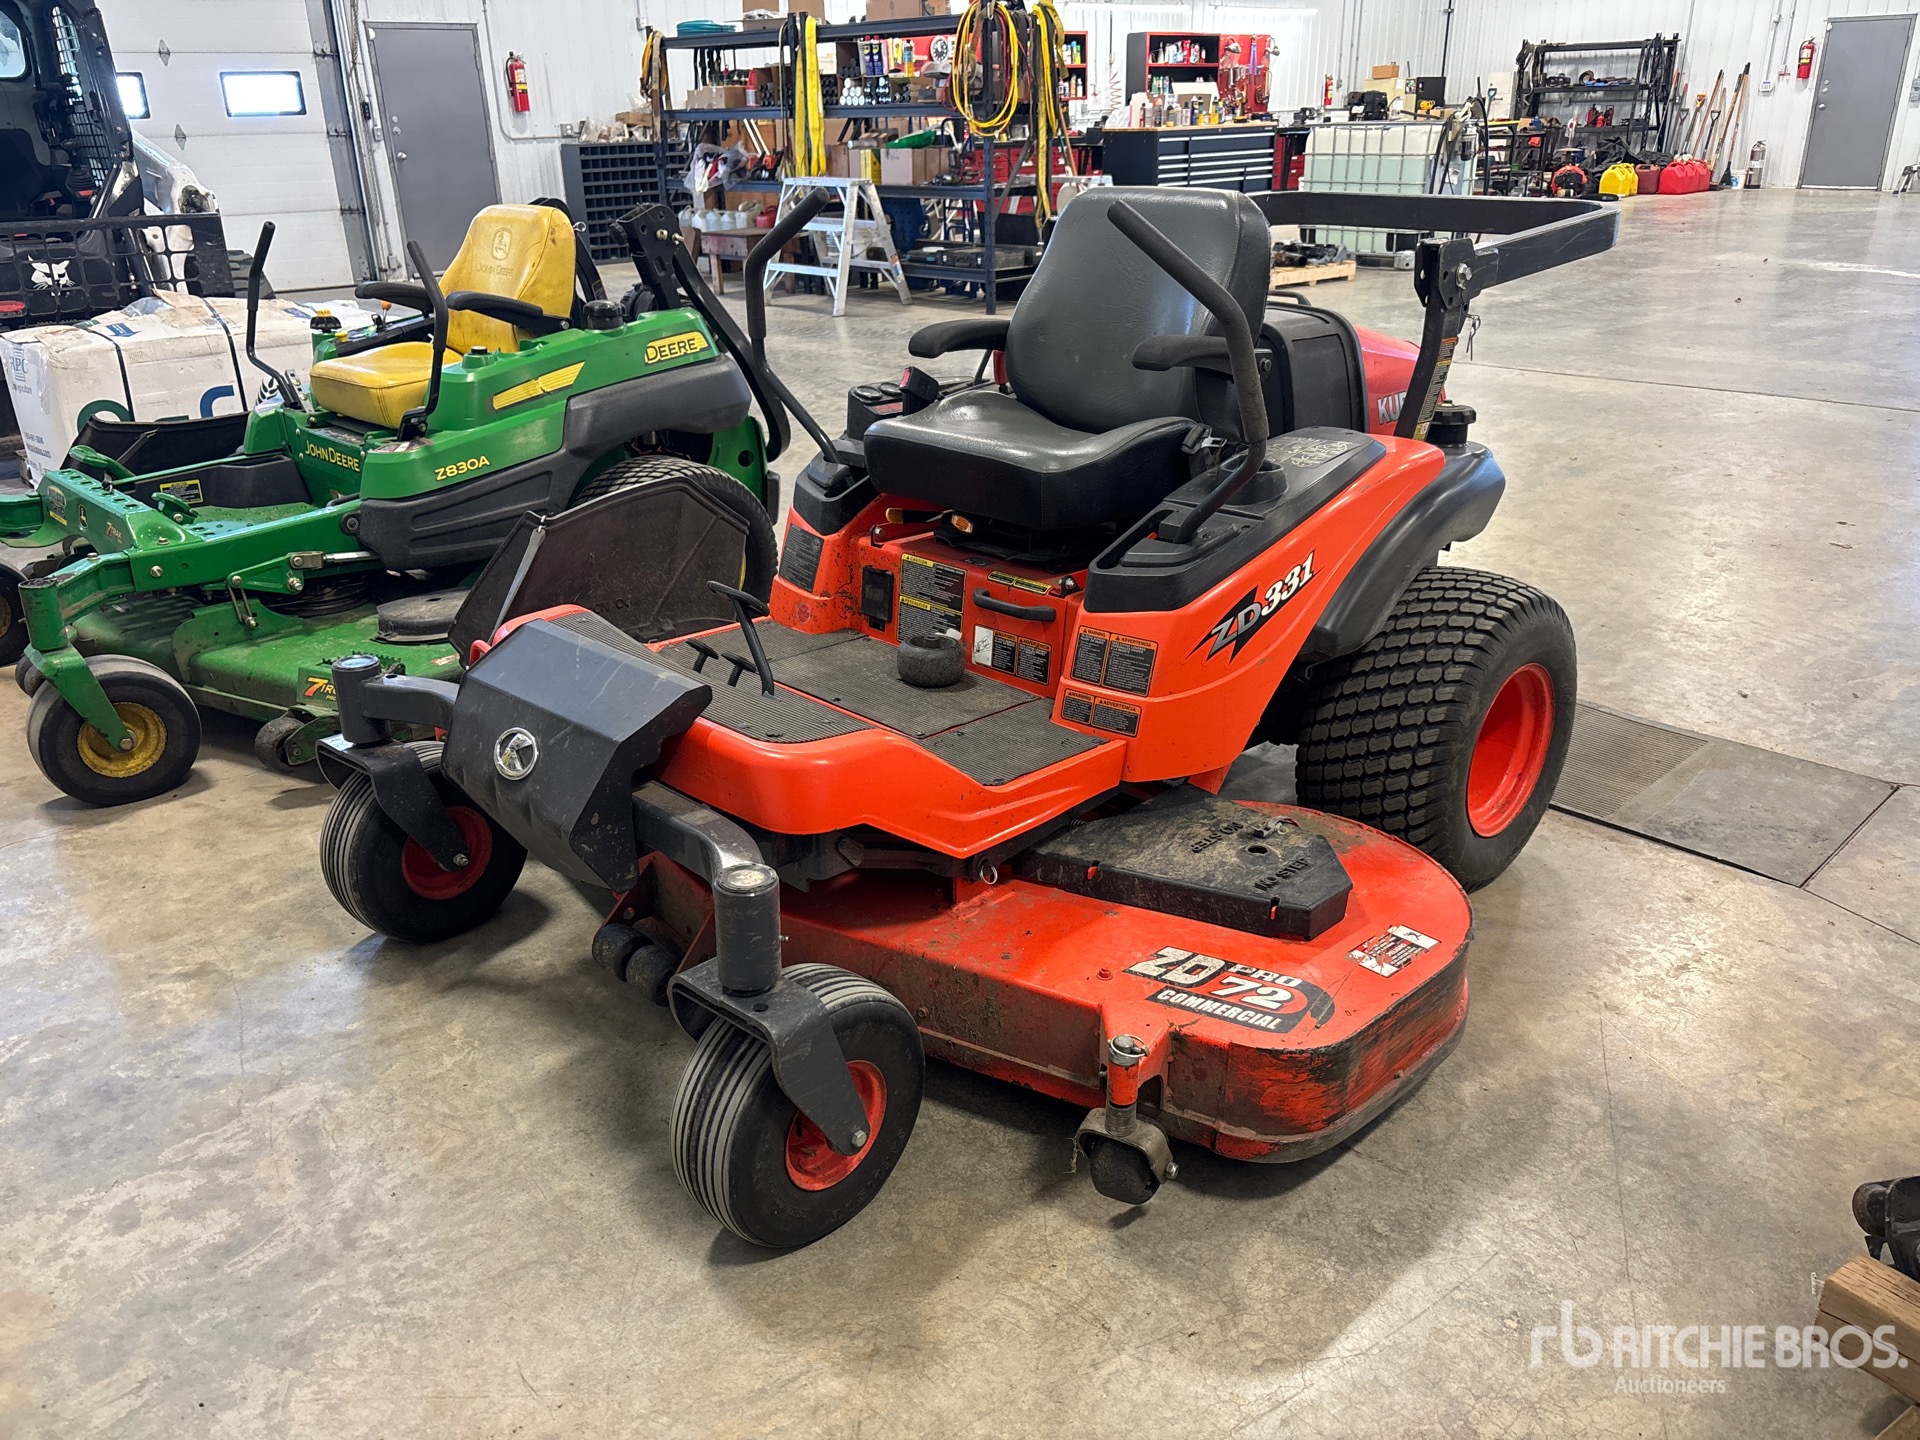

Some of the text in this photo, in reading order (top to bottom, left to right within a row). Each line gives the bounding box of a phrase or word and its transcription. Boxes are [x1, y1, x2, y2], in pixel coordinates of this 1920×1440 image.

[646, 338, 698, 362] DEERE
[305, 440, 360, 472] JOHN DEERE
[434, 455, 491, 481] Z830A
[1207, 551, 1316, 660] ZD331
[1088, 629, 1106, 638] WARNING
[1121, 637, 1152, 648] ADVERTENCIA
[1103, 700, 1137, 712] ADVERTENCIA
[1221, 821, 1244, 835] NO
[1254, 855, 1309, 892] NO STEP
[1130, 946, 1303, 988] ZD PRO
[1210, 976, 1294, 1010] 72
[1157, 989, 1284, 1030] COMMERCIAL
